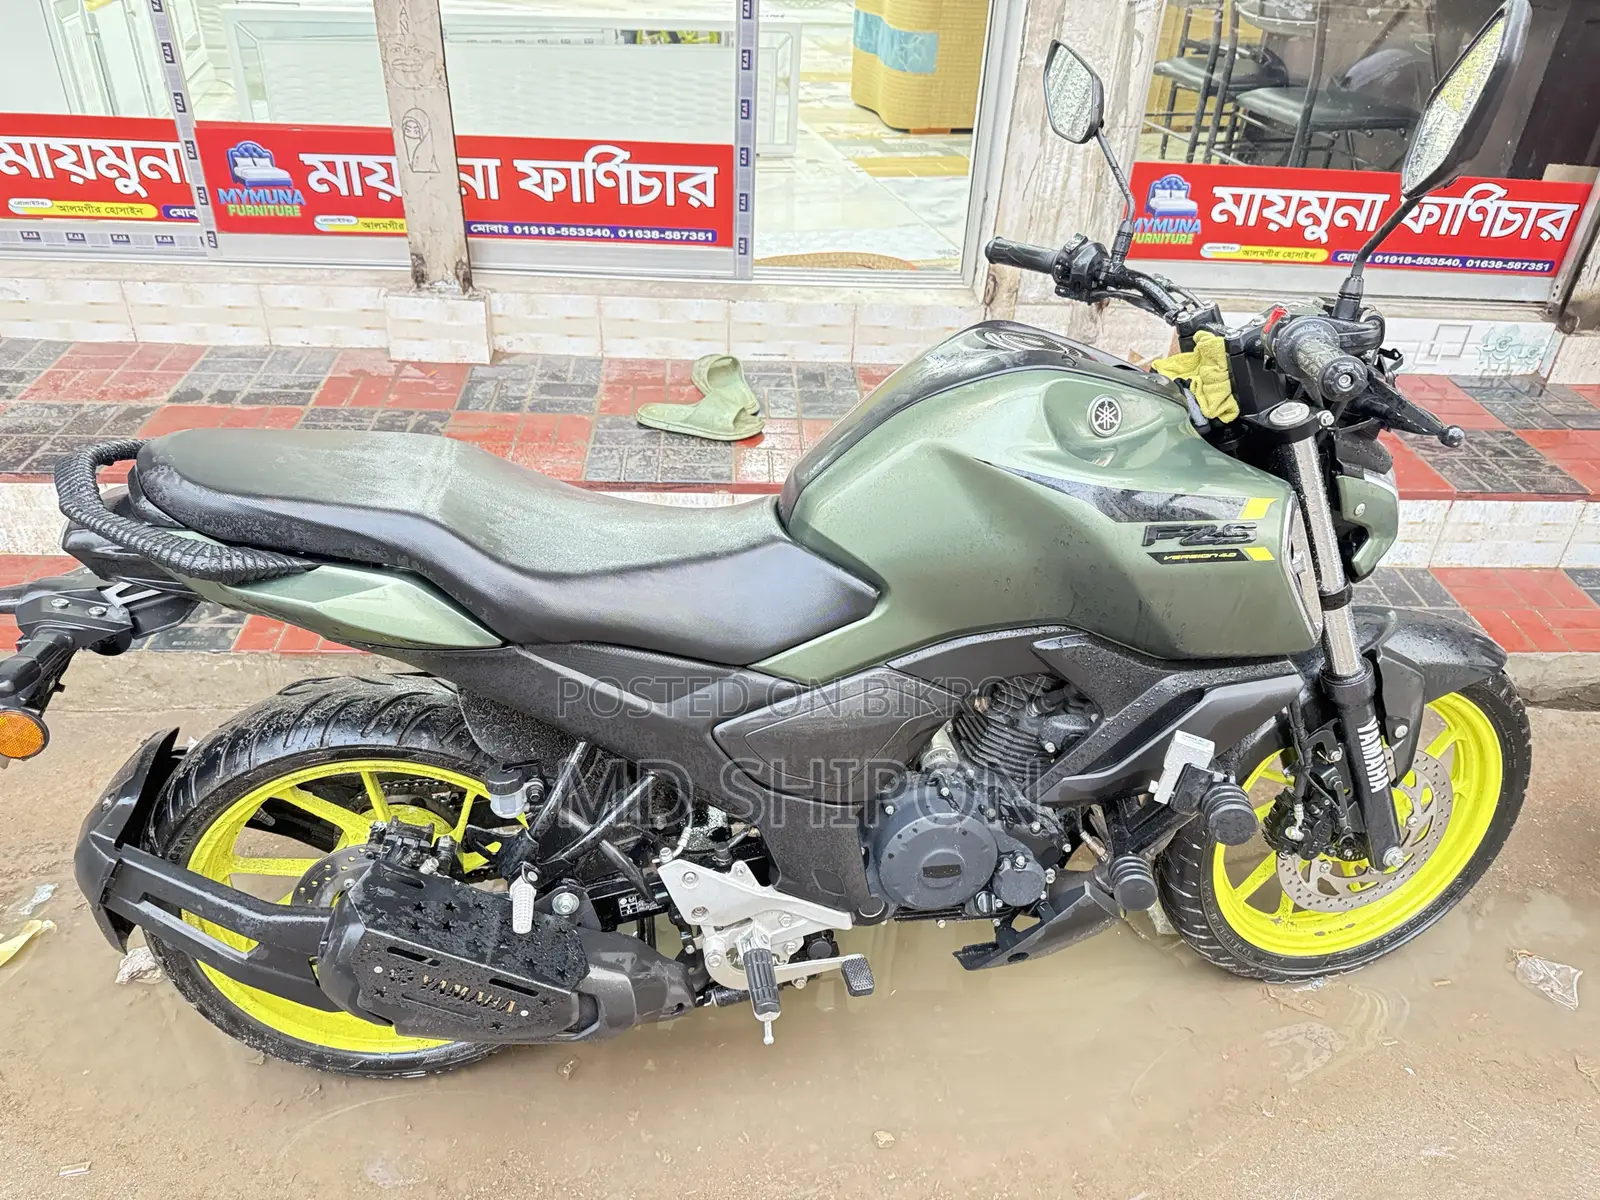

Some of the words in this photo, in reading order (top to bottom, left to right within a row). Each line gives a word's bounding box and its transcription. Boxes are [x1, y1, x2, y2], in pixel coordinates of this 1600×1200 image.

[512, 144, 718, 209] ফার্ণিচার
[218, 189, 306, 206] MYMUNA
[56, 203, 101, 214] আলমগীর
[105, 205, 144, 216] হোসাইন
[227, 205, 301, 217] FURNITURE
[1210, 186, 1389, 245] মায়মুনা
[513, 225, 615, 239] 01918-553540,
[618, 229, 714, 242] 01638-587351
[1465, 259, 1551, 271] 01638-587351
[1357, 715, 1390, 794] YAMAHA
